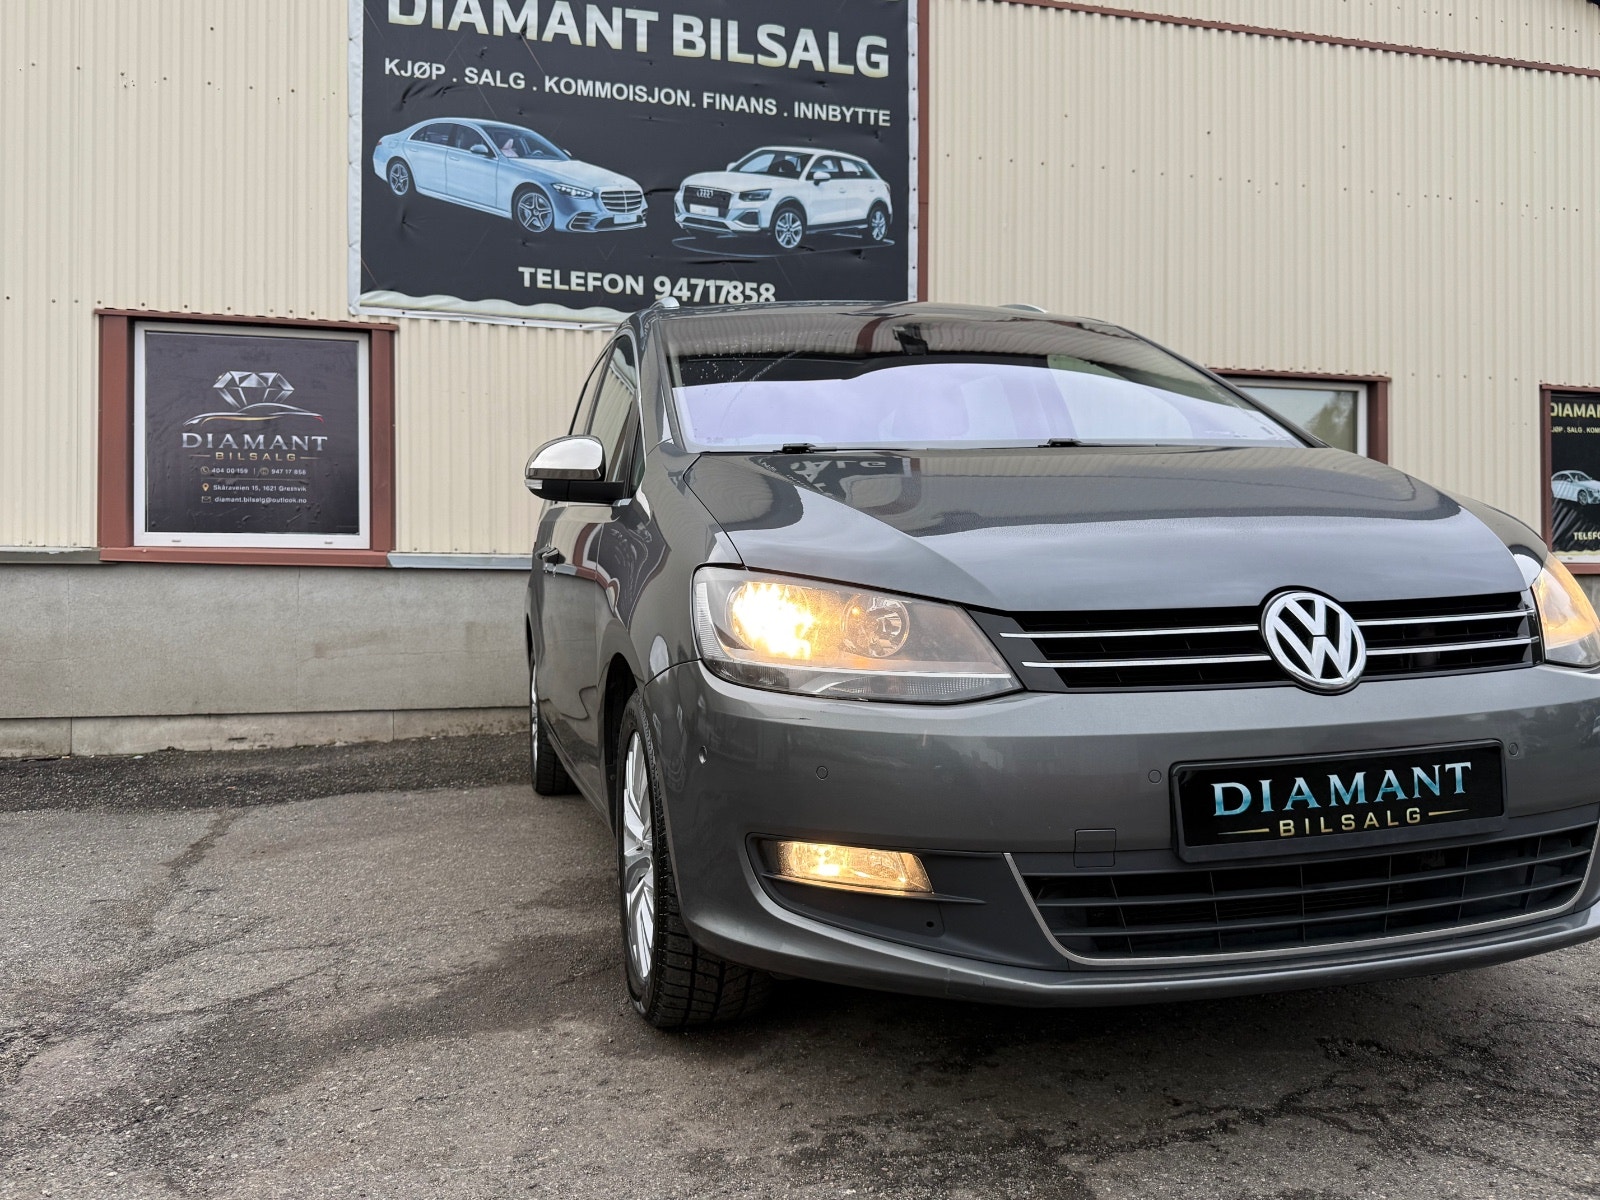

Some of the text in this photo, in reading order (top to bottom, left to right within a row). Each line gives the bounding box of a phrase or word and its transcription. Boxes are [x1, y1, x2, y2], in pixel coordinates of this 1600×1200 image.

[388, 0, 890, 79] DIAMANT BILSALG
[384, 57, 446, 80] KJØP
[464, 66, 526, 90] SALG
[544, 75, 697, 108] KOMMOISJON.
[702, 92, 778, 117] FINANS
[793, 101, 891, 127] INNBYTTE
[518, 266, 776, 304] TELEFON 94717858
[182, 432, 328, 451] DIAMANT
[215, 451, 296, 462] BILSALG
[1210, 761, 1472, 817] DIAMANT
[1279, 807, 1421, 837] BILSALG
